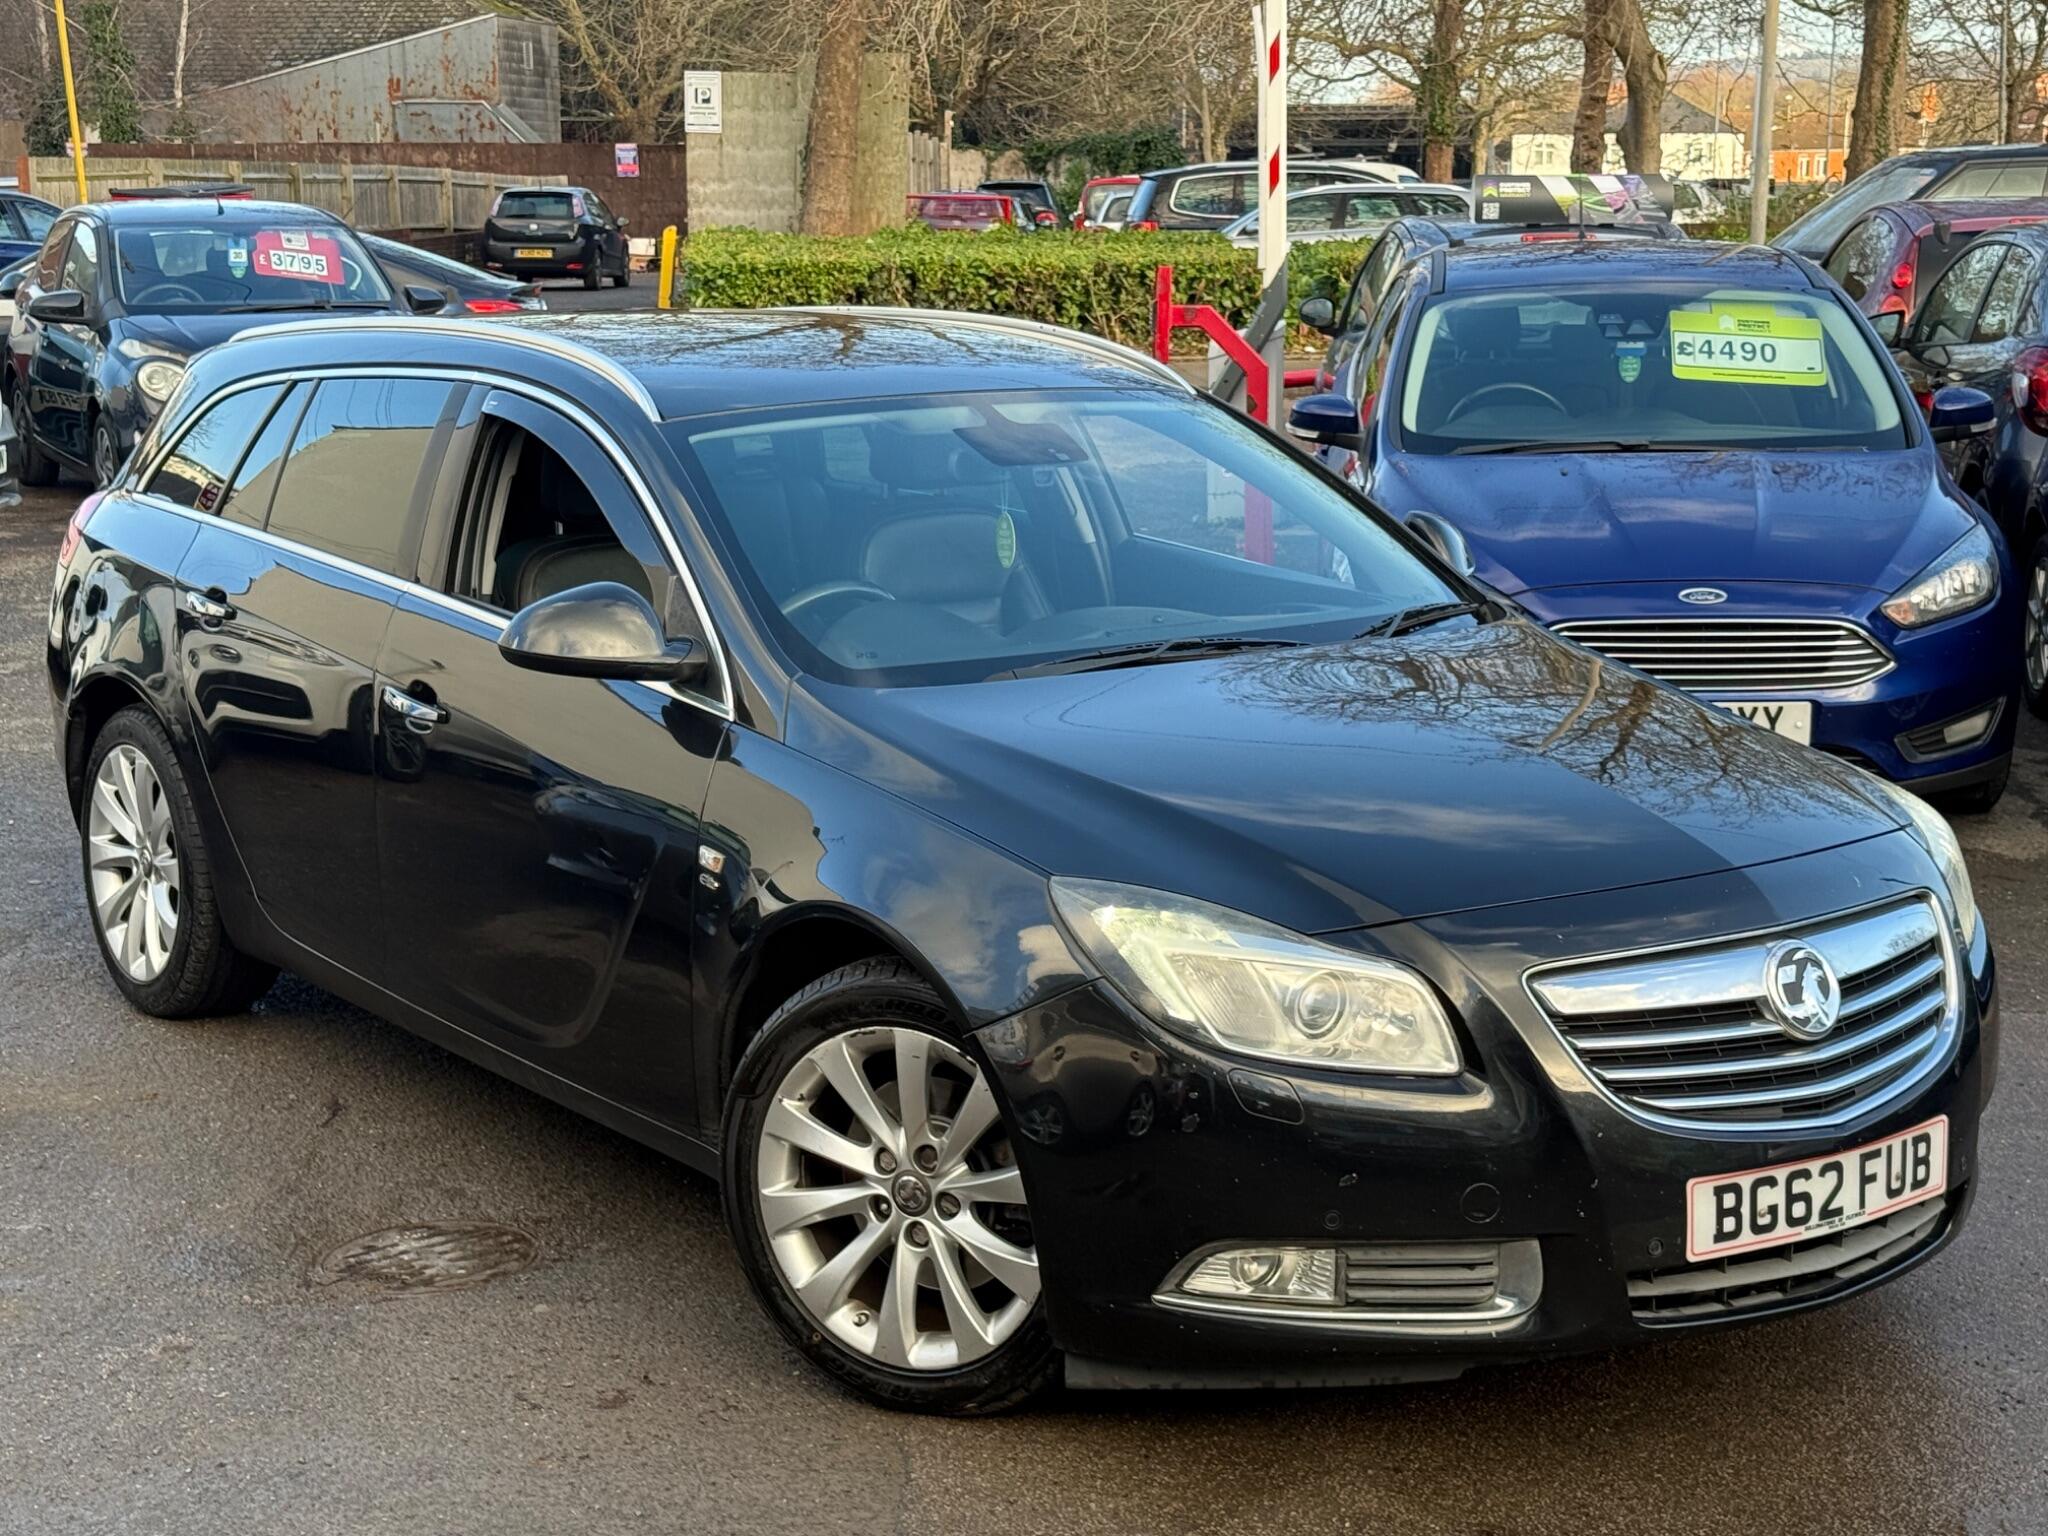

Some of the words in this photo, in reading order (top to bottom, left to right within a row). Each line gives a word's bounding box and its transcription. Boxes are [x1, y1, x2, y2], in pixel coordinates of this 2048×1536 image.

[1676, 339, 1777, 363] £4490
[1713, 1160, 1844, 1244] BG62
[1859, 1131, 1931, 1211] FUB
